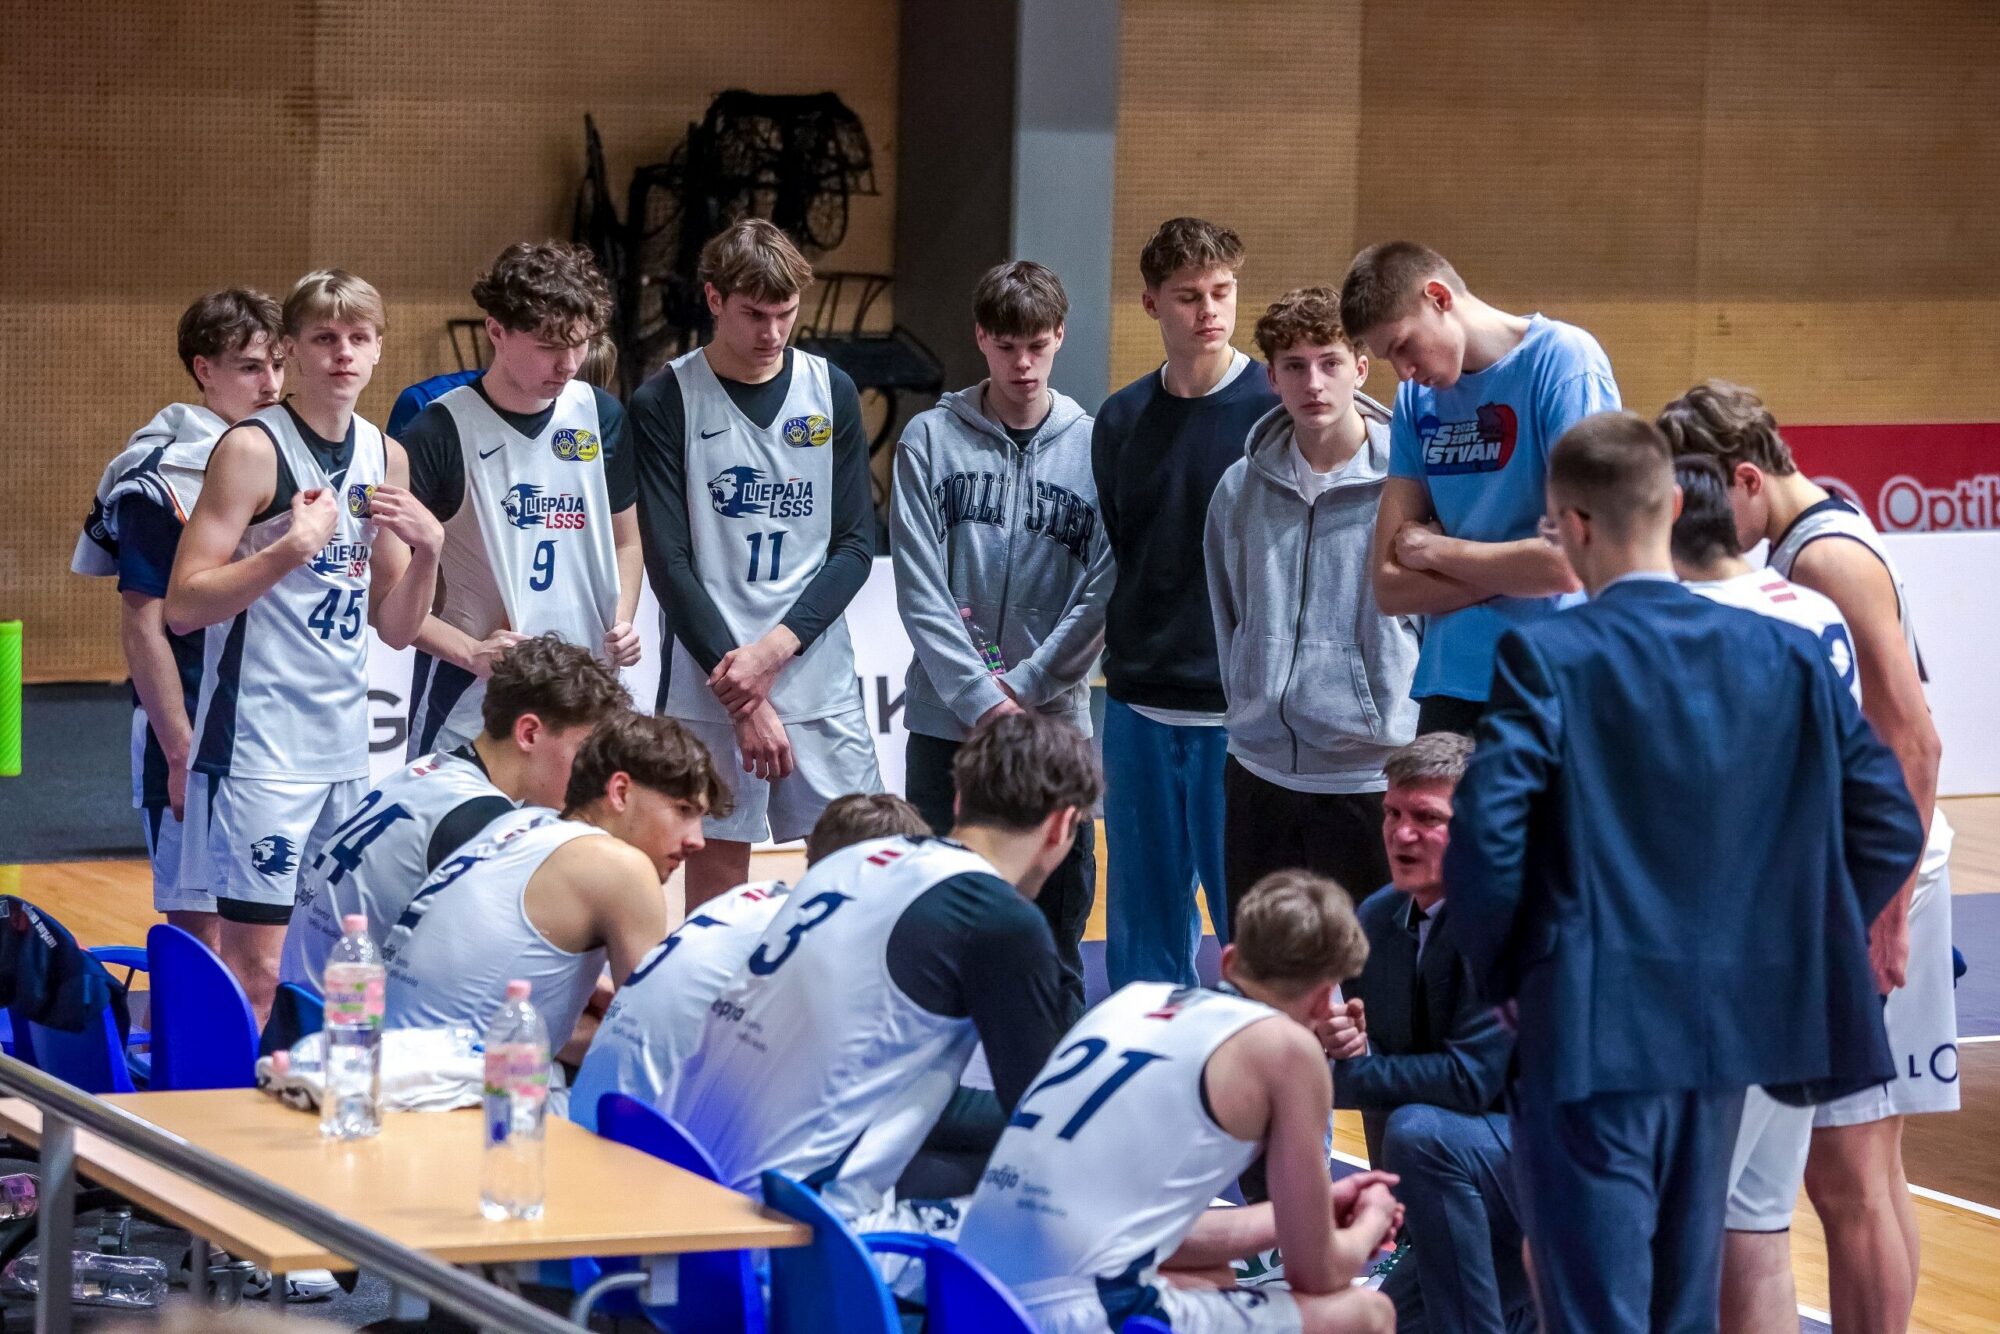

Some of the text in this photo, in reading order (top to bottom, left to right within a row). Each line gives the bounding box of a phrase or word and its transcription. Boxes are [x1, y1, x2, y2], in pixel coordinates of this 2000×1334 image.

[545, 513, 586, 530] LSSS
[769, 501, 814, 519] LSSS
[529, 540, 559, 592] 9
[746, 531, 789, 582] 11
[308, 588, 366, 641] 45
[312, 789, 416, 886] 24
[748, 891, 856, 976] 3
[1008, 1037, 1174, 1141] 21
